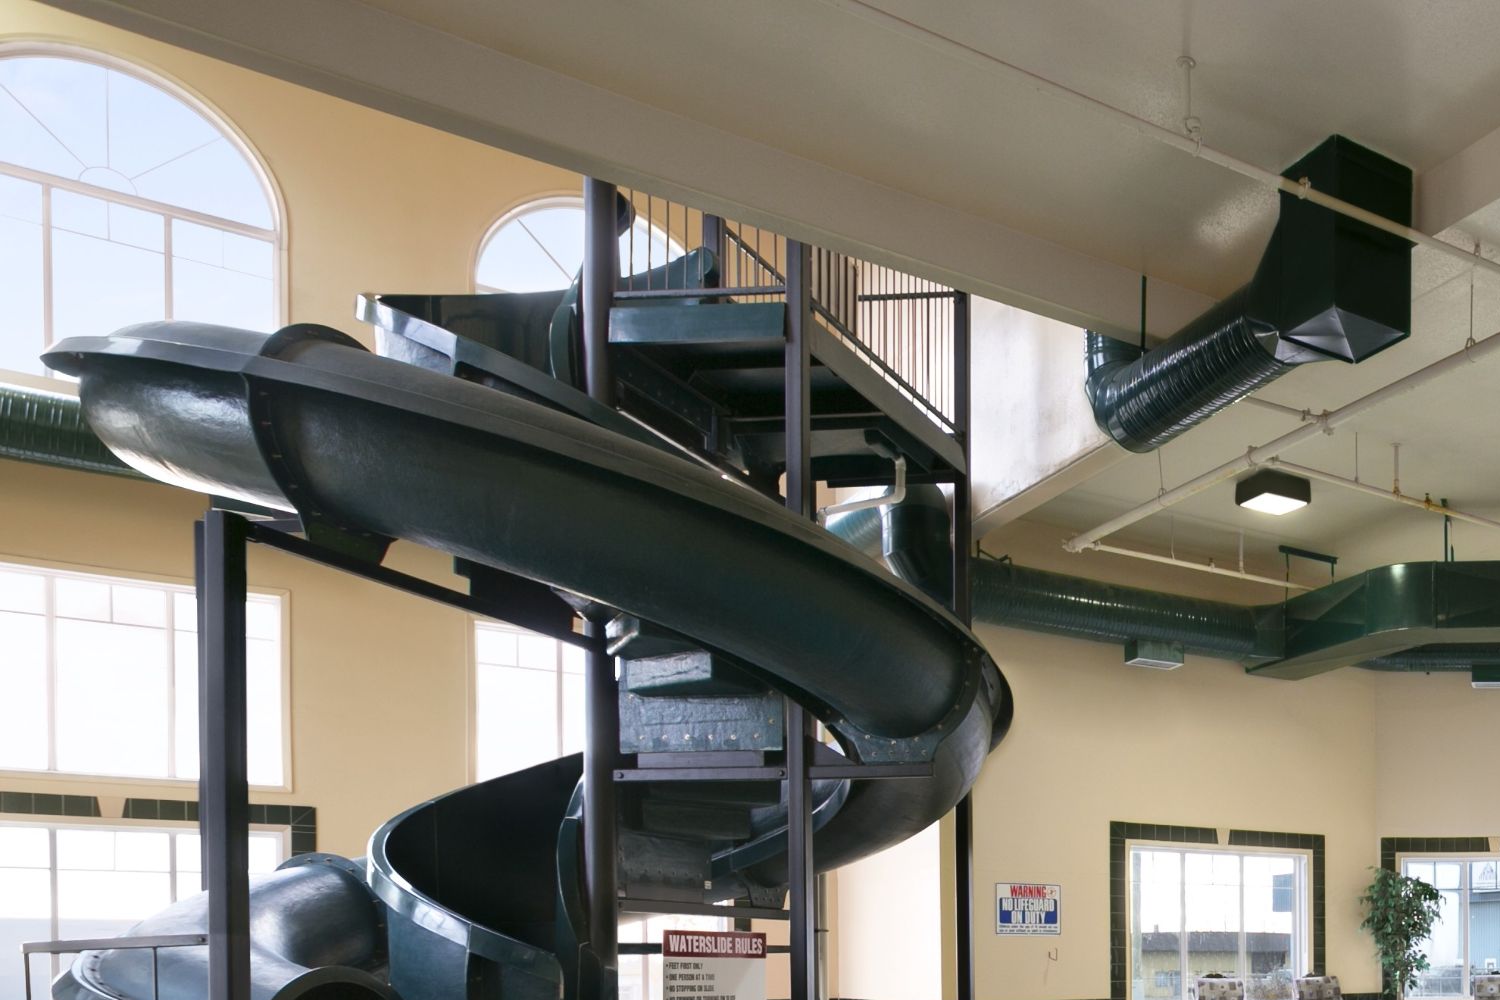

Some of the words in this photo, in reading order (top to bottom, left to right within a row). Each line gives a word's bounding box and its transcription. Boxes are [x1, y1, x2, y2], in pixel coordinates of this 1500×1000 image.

[1010, 885, 1046, 898] WARNING
[1002, 898, 1013, 911] NO
[1014, 898, 1055, 912] LIFEGUARD
[1011, 911, 1023, 924] ON
[1025, 911, 1046, 924] DUTY
[669, 934, 733, 954] WATERSLIDE
[735, 937, 763, 955] RULES
